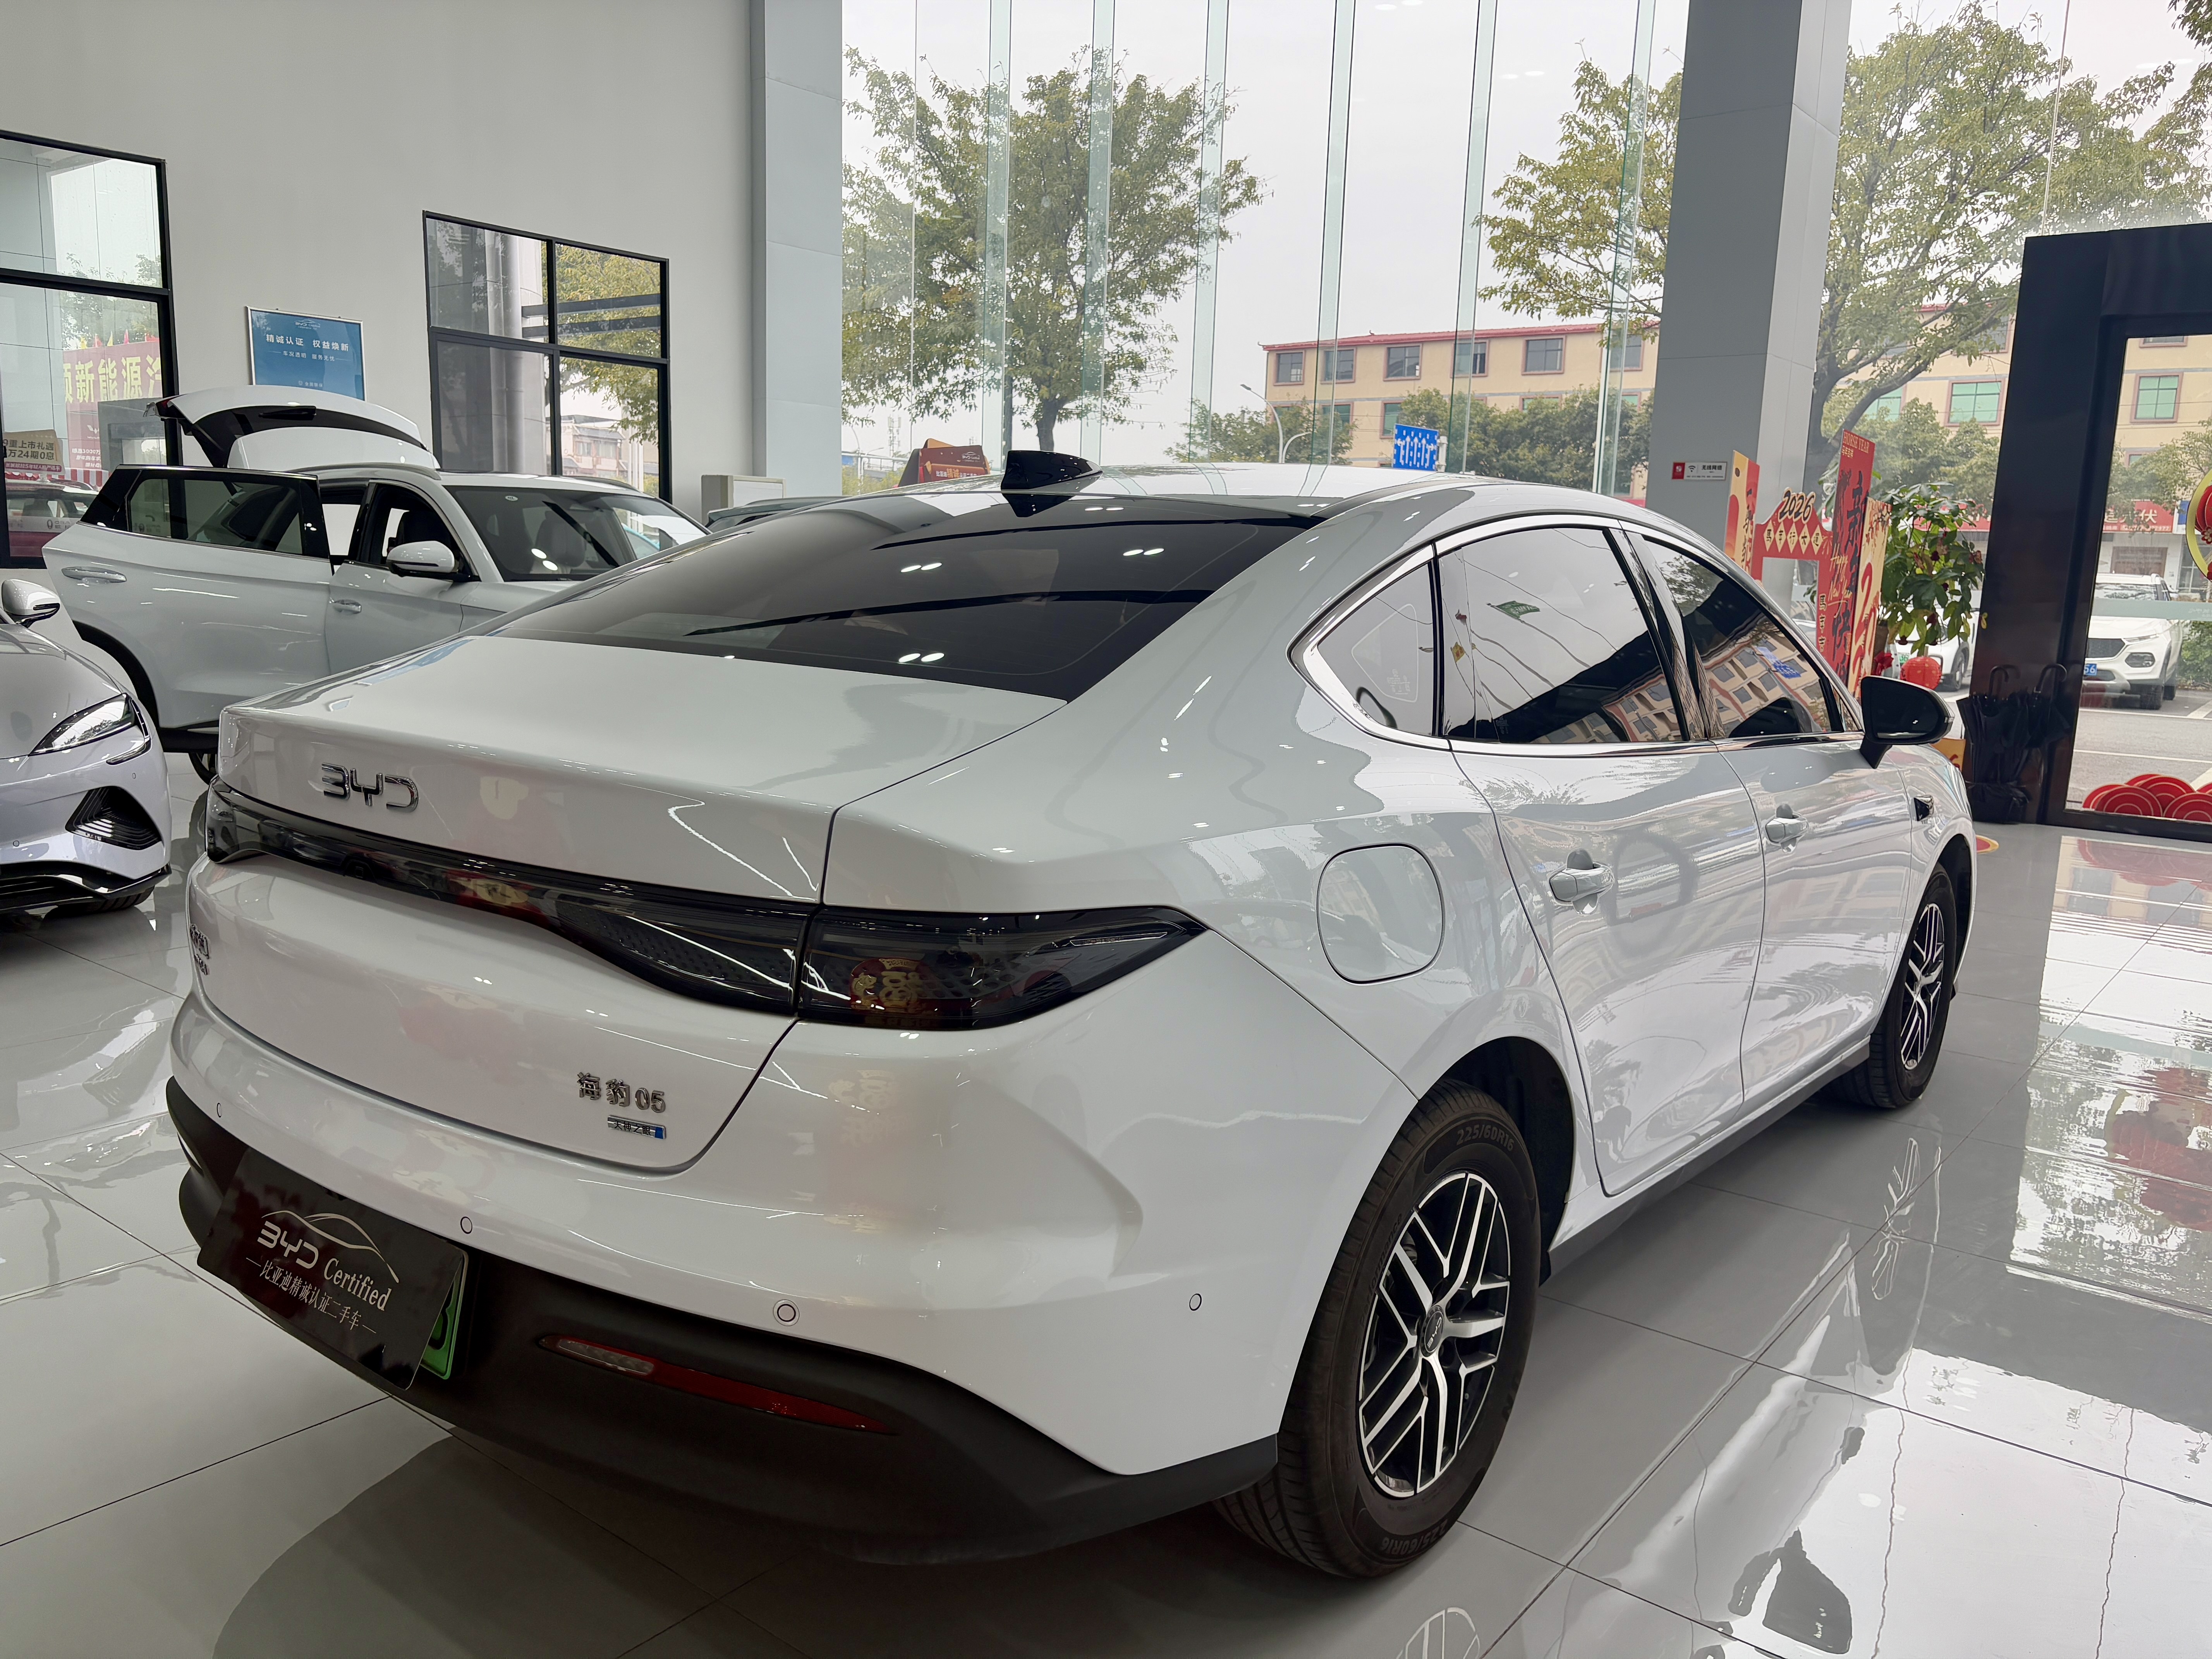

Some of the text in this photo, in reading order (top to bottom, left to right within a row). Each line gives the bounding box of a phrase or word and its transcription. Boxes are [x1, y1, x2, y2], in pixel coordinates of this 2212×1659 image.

[266, 334, 349, 352] 精诚认证 权益焕新
[283, 350, 335, 362] 车况透明 服务无忧
[1843, 431, 1870, 454] HORSE YEAR
[1778, 488, 1815, 523] 2026
[321, 762, 419, 813] BYD
[614, 1120, 651, 1136] 天神之眼
[1456, 1124, 1515, 1152] 225/60R16
[257, 1220, 392, 1311] BYD Certified
[259, 1259, 362, 1331] 比亚迪精诚认证二手车
[1427, 1317, 1442, 1348] BYD
